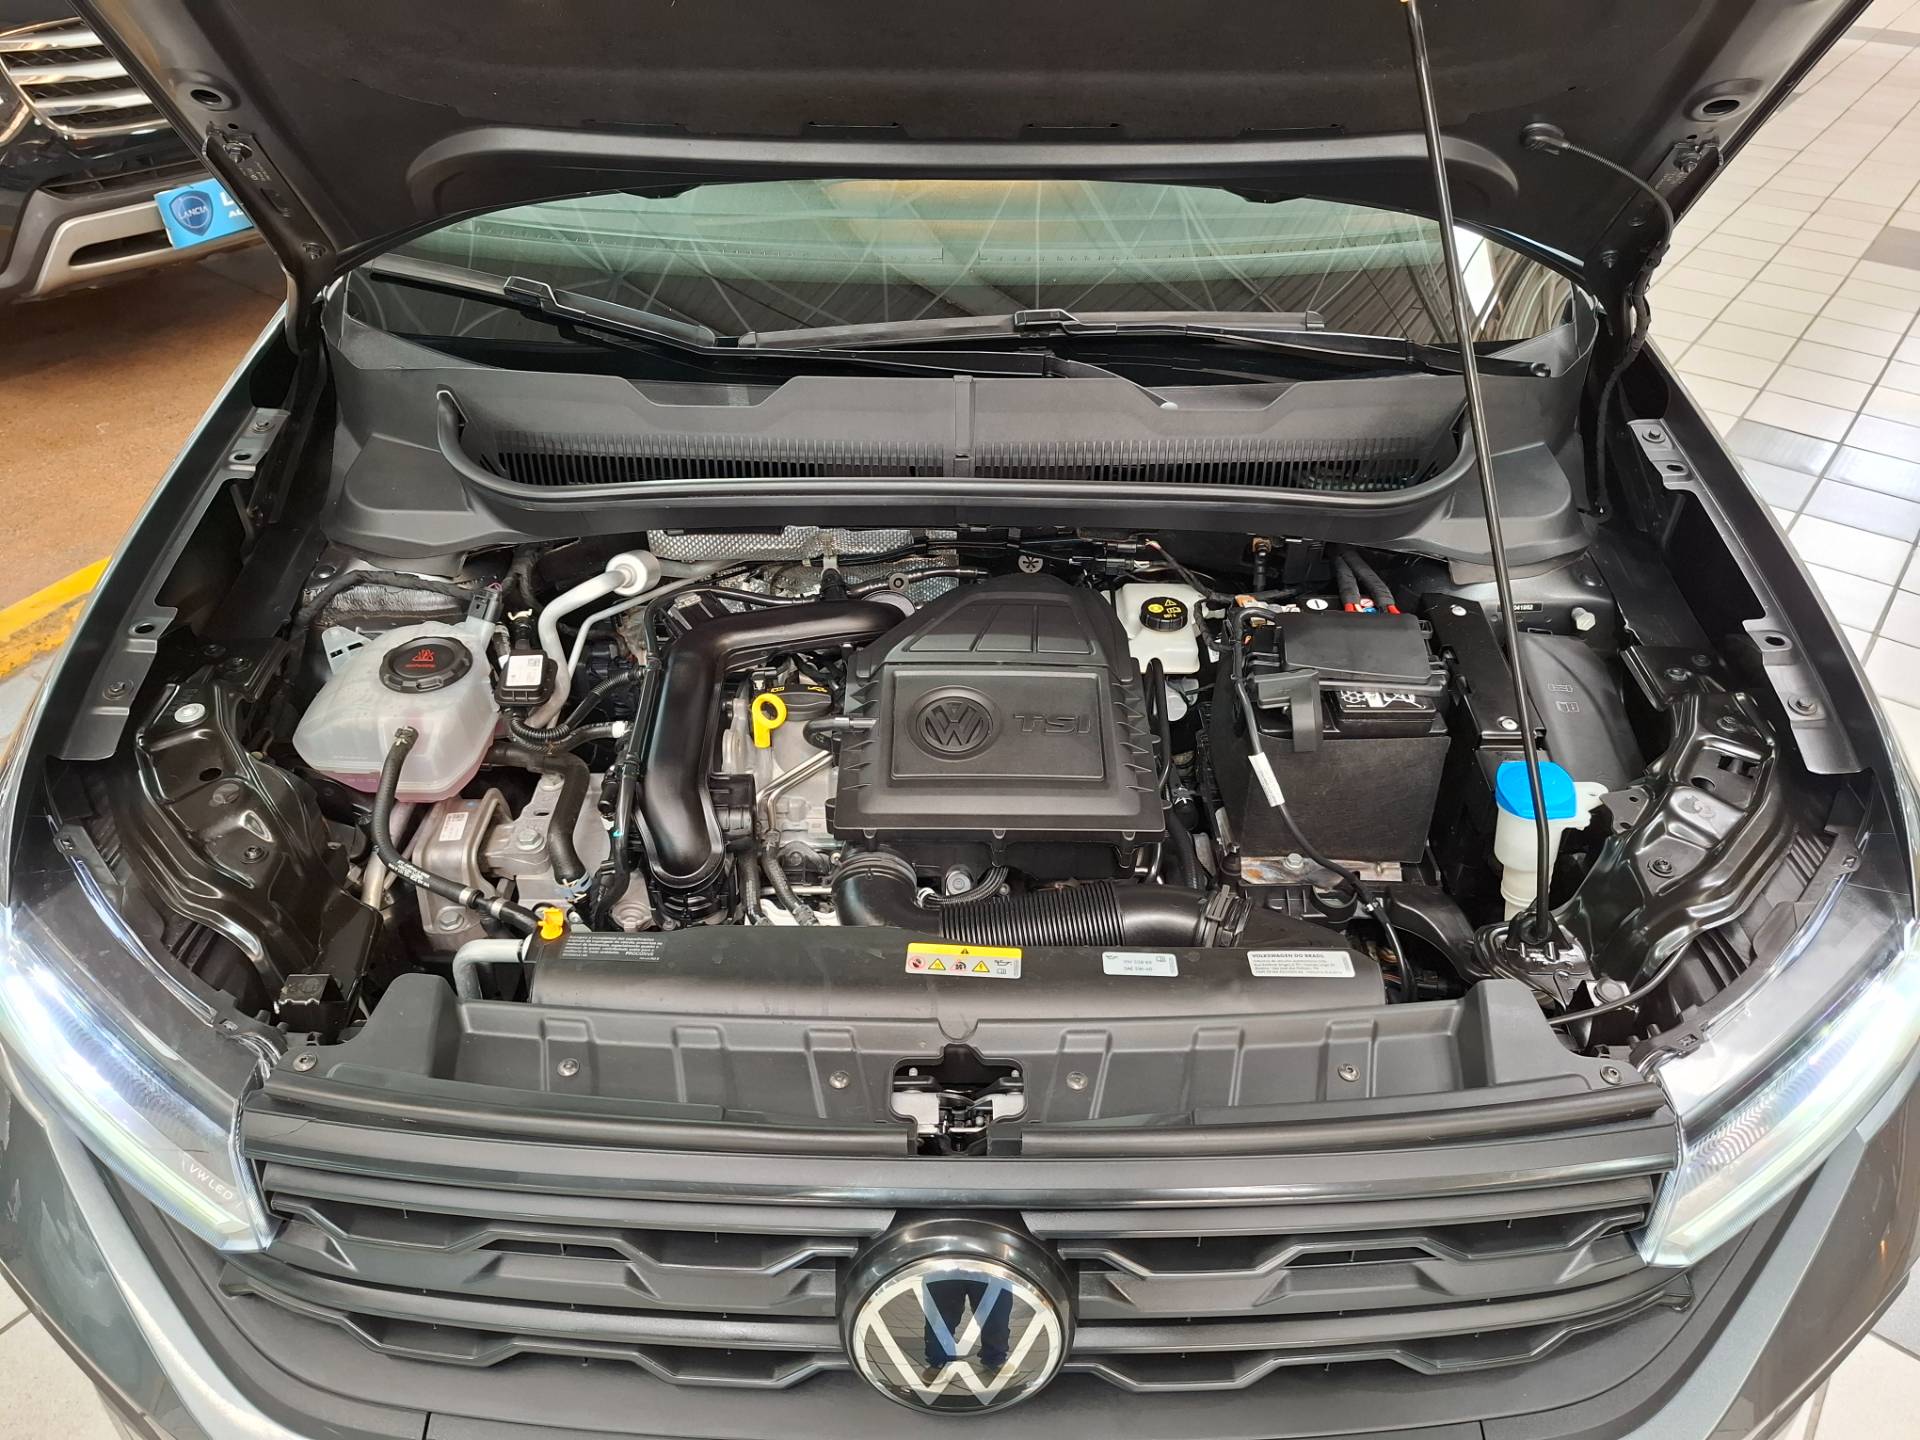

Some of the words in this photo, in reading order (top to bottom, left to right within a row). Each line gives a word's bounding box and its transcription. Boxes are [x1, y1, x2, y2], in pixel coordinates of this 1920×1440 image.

[179, 205, 208, 220] LANCIA
[1013, 713, 1091, 734] TSI
[190, 1163, 210, 1181] VW
[208, 1179, 233, 1200] LED
[856, 1263, 1058, 1408] VW
